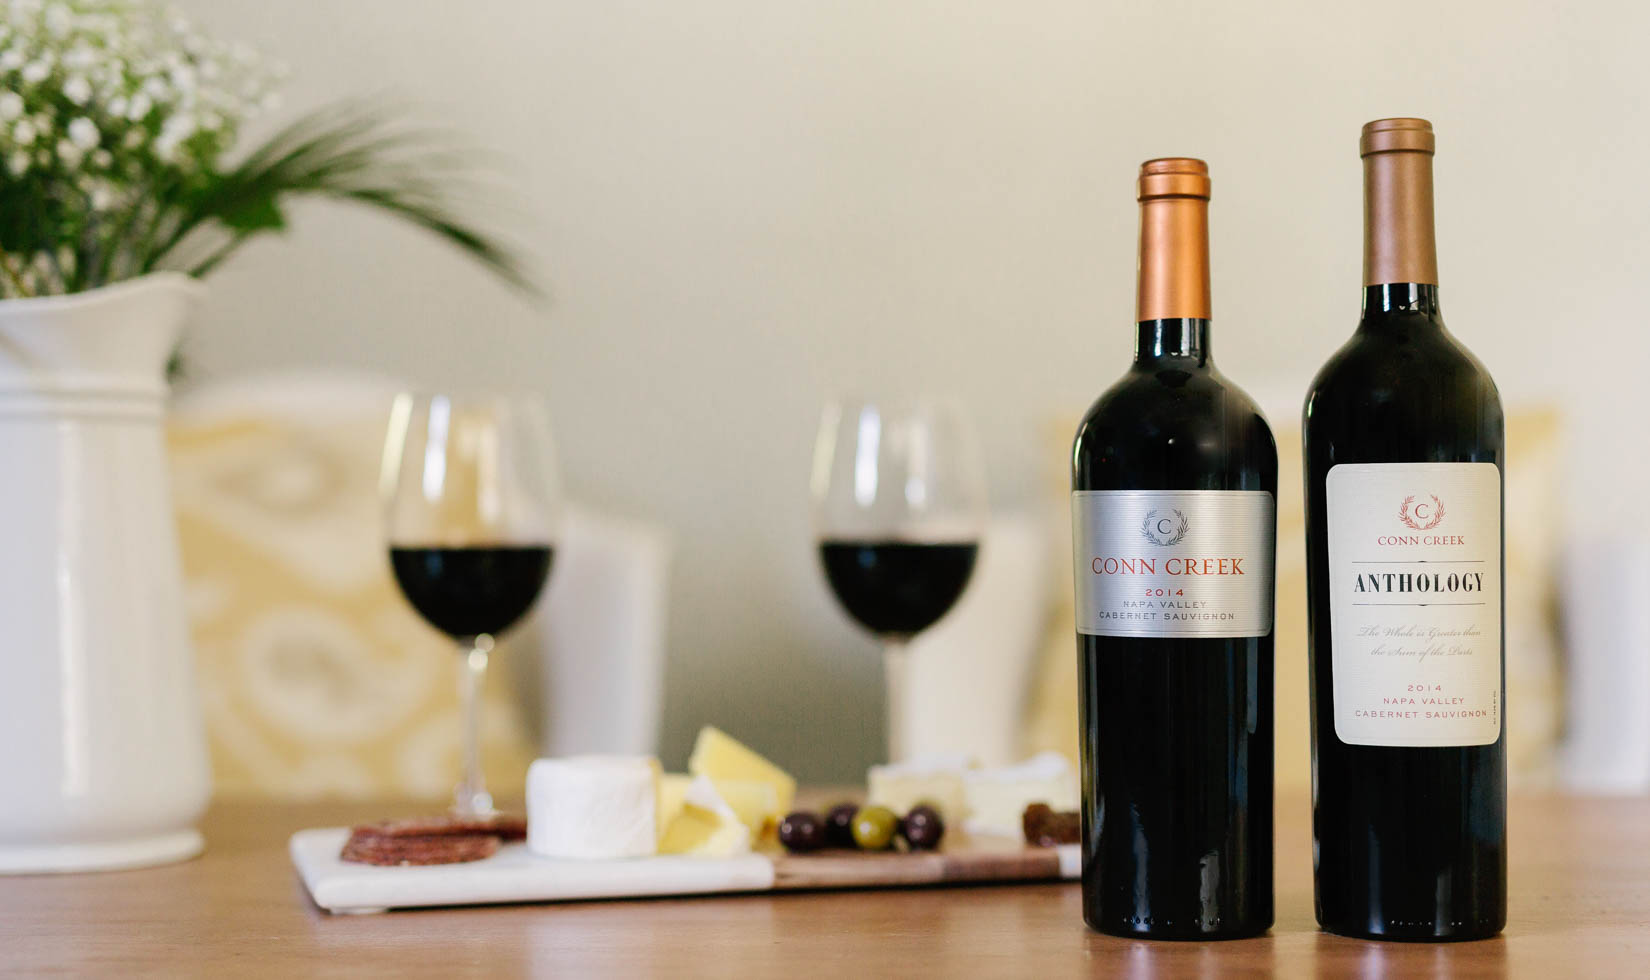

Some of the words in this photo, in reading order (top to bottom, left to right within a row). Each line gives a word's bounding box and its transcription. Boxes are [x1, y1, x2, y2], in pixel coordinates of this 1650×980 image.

[1415, 504, 1429, 519] C
[1157, 519, 1171, 534] C
[1377, 536, 1419, 546] CONN
[1423, 536, 1465, 546] CREEK
[1092, 557, 1157, 574] CONN
[1165, 558, 1245, 575] CREEK
[1354, 573, 1484, 592] ANTHOLOGY
[1145, 588, 1184, 597] 2014
[1123, 601, 1154, 609] NAPA
[1160, 601, 1207, 609] VALLEY
[1099, 611, 1157, 620] CABERNET
[1163, 612, 1234, 621] SAUVIGNON
[1357, 624, 1380, 637] The
[1382, 624, 1414, 637] Whole
[1462, 624, 1481, 636] than
[1370, 644, 1386, 656] the
[1387, 646, 1416, 656] Sum
[1417, 645, 1431, 664] of
[1430, 644, 1445, 656] the
[1355, 710, 1419, 719] CABERNET
[1425, 710, 1487, 719] SAUVIGNON
